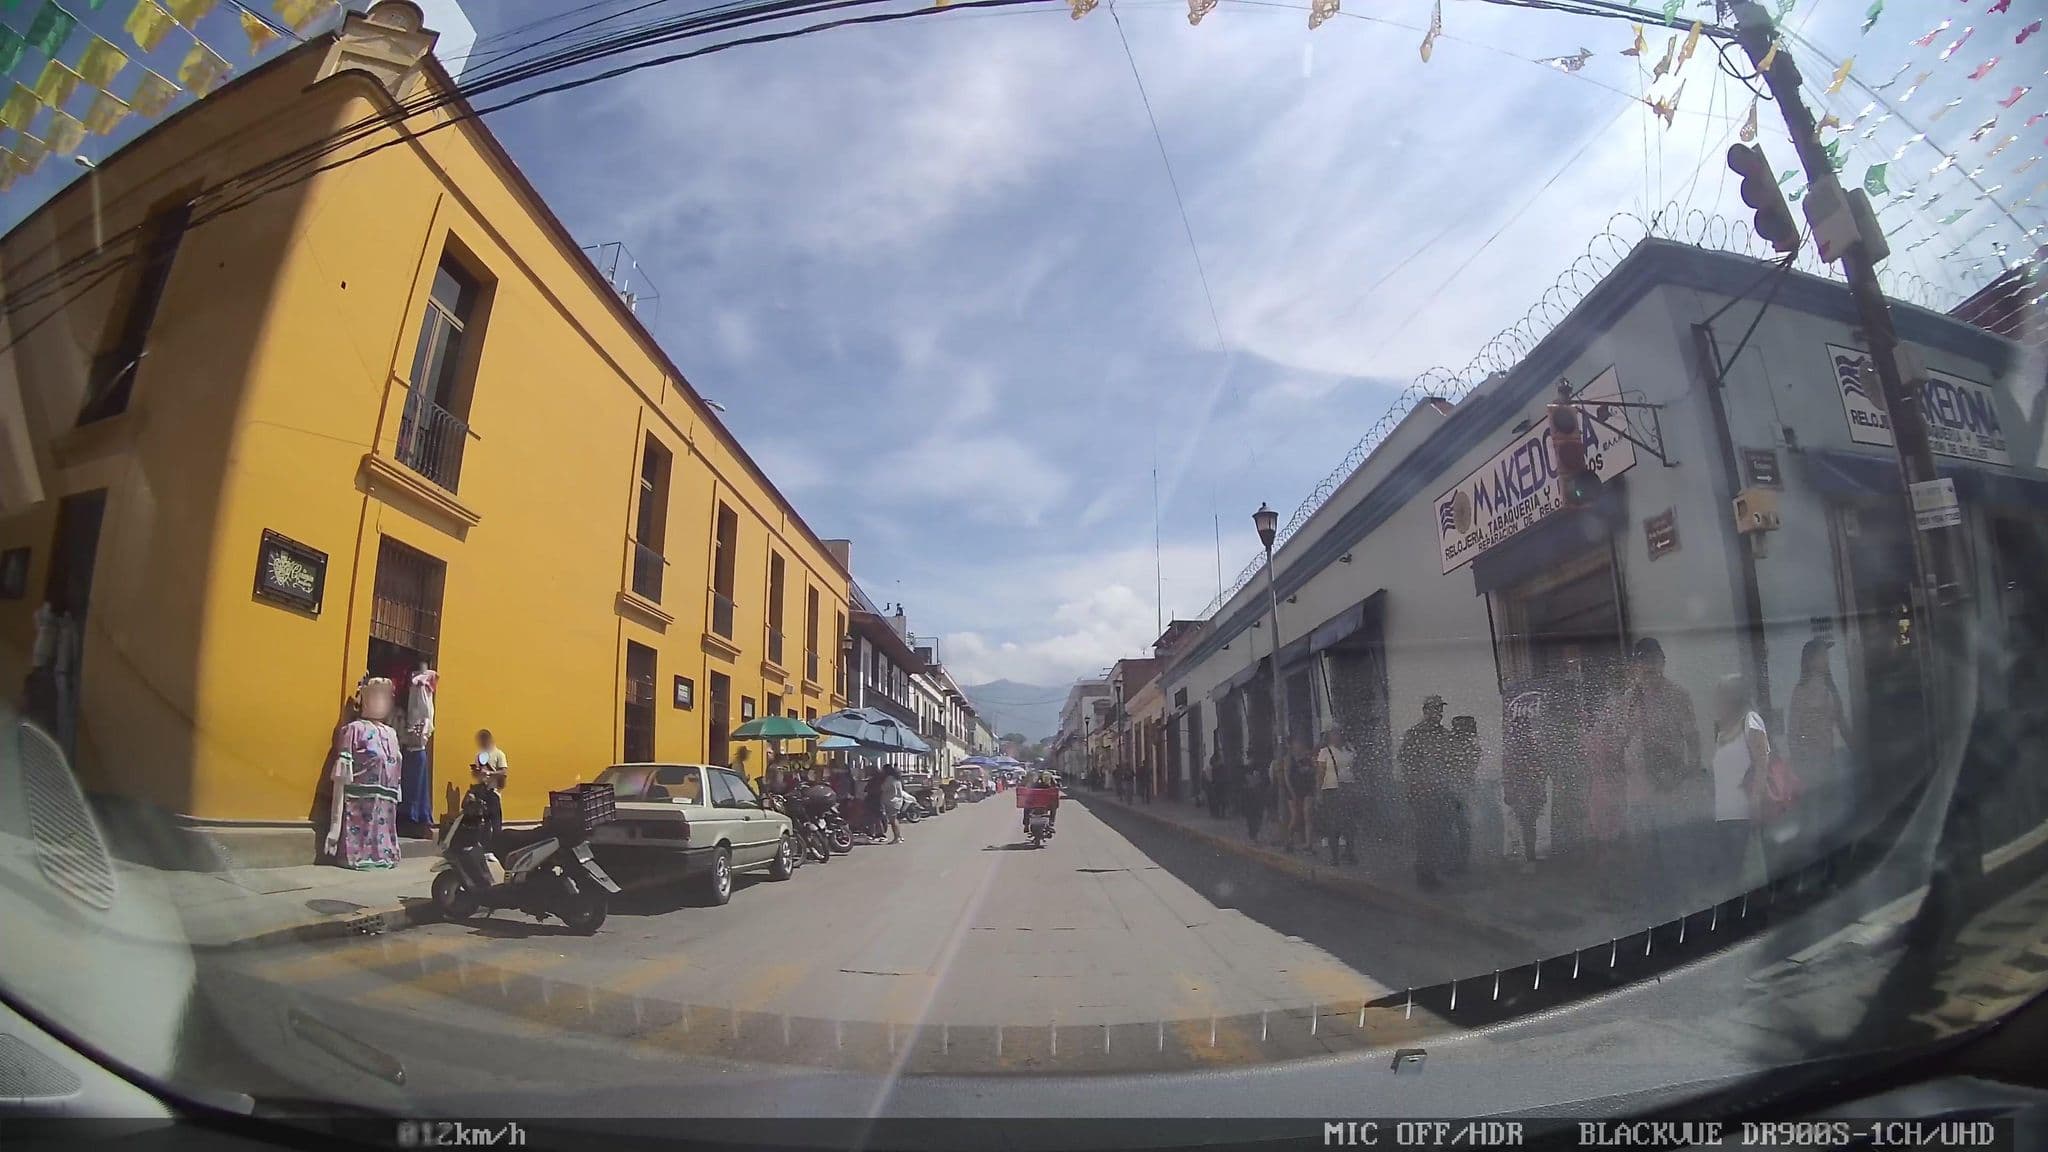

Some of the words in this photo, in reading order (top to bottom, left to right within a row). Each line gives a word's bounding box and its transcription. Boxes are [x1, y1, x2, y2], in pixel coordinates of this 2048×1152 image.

[1488, 494, 1541, 535] TABAQUERIA
[1543, 485, 1552, 502] Y
[1523, 513, 1534, 527] DE
